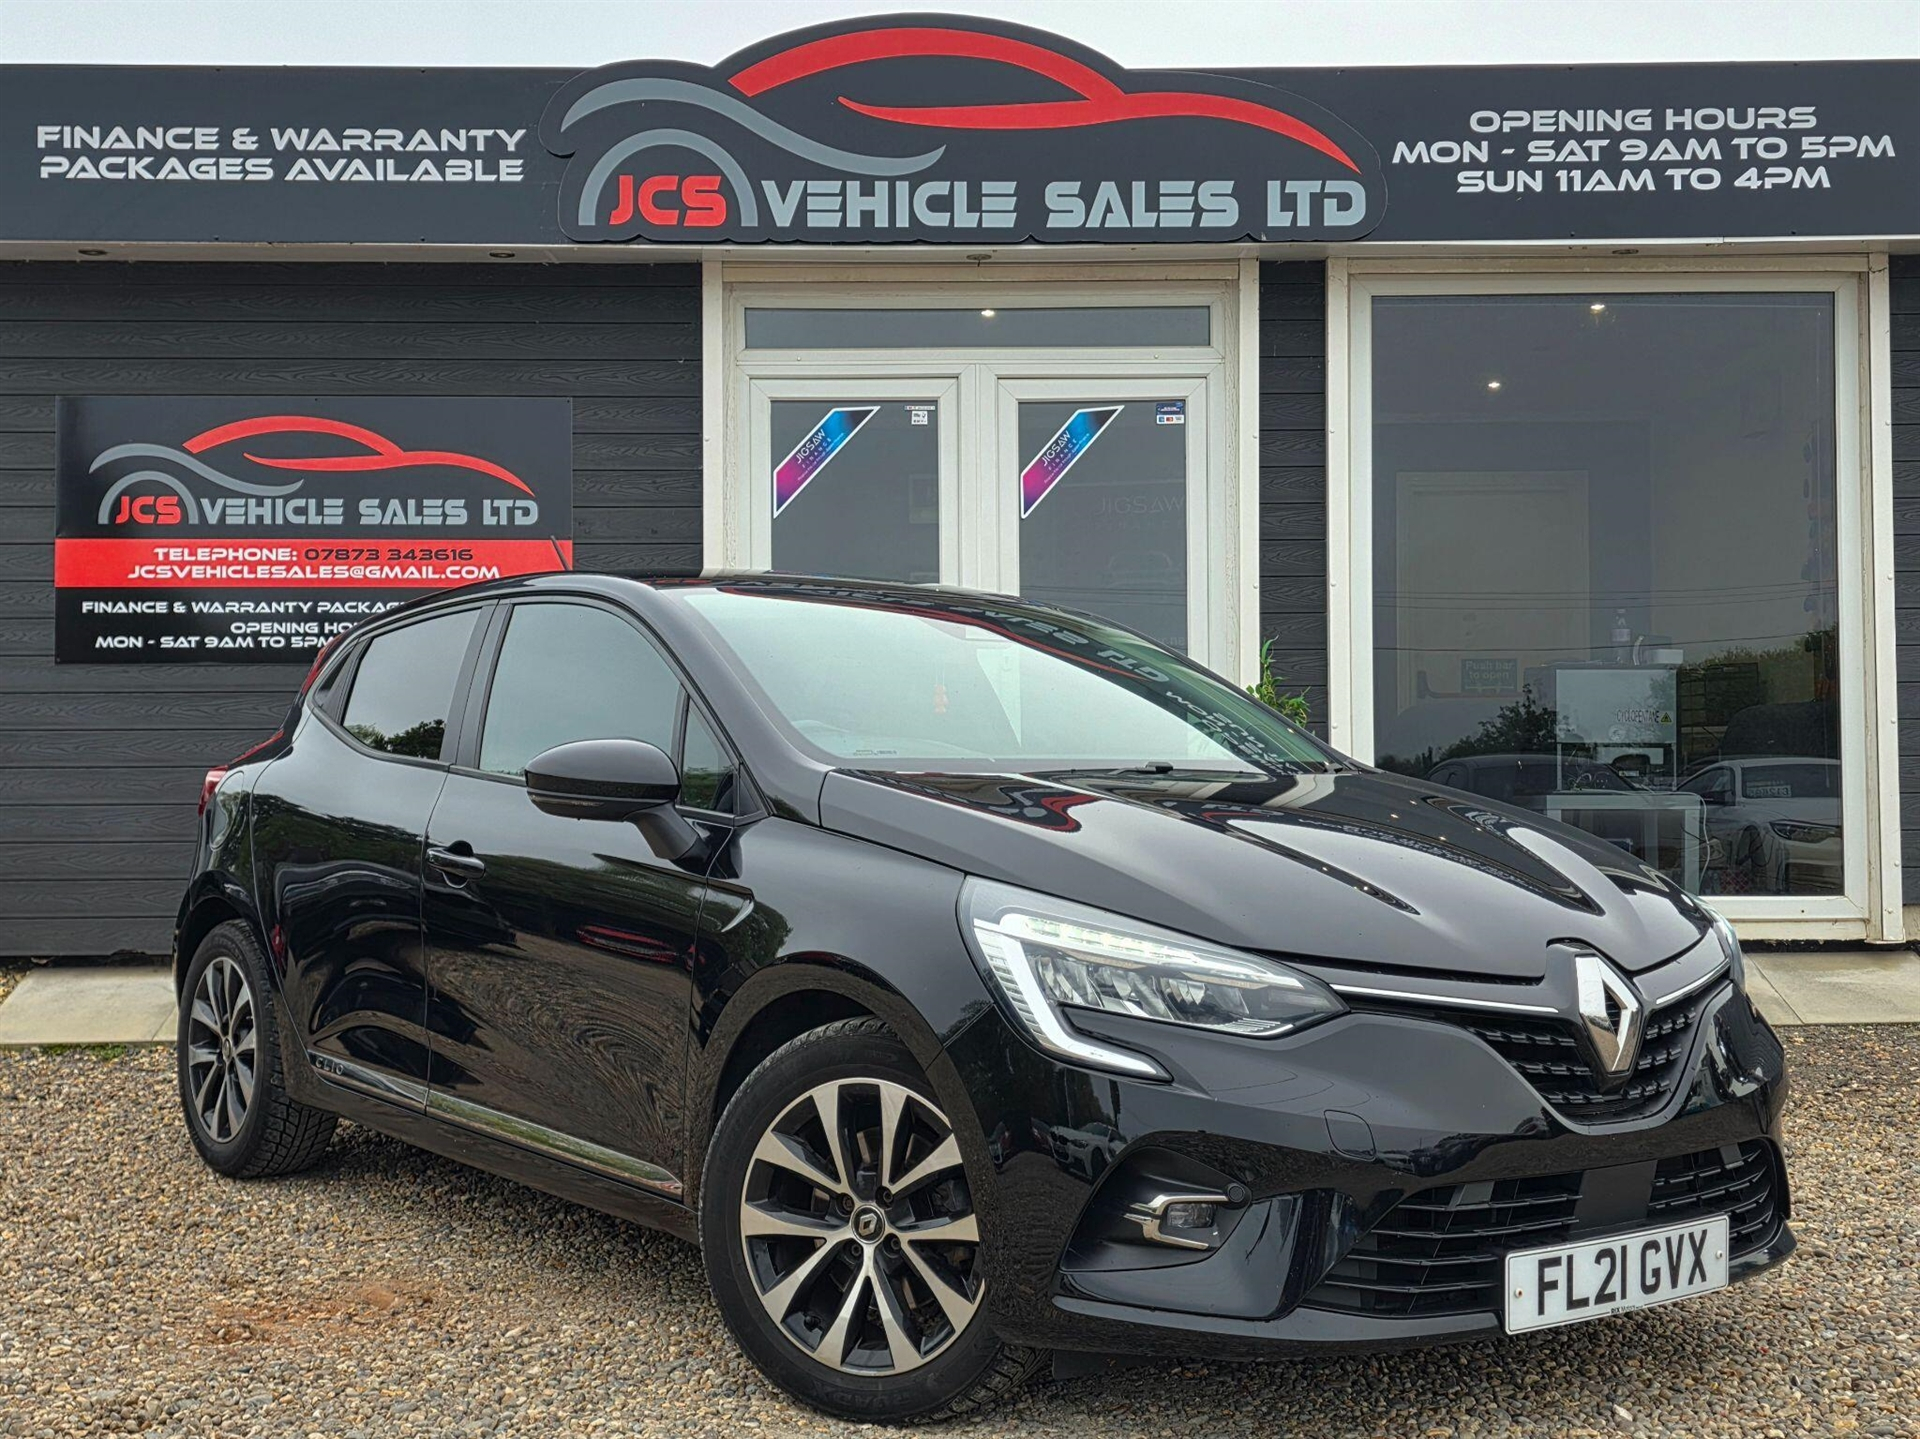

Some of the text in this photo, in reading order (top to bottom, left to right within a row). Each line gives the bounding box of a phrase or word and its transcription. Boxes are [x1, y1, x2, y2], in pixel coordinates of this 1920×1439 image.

[1469, 106, 1817, 133] OPENING HOURS
[37, 125, 527, 152] FINANCE & WARRANTY
[1391, 140, 1489, 164] MON
[1527, 139, 1611, 163] SAT
[1619, 137, 1723, 162] 9AM
[1730, 136, 1788, 160] TO
[1800, 134, 1896, 159] 5PM
[40, 155, 525, 182] PACKAGES AVAILABLE
[1456, 165, 1831, 193] SUN 11AM TO 4PM
[608, 174, 1367, 228] JCS VEHICLE SALES LTD
[796, 428, 826, 464] JIGSAW
[1041, 429, 1071, 467] JIGSAW
[114, 495, 539, 526] JCS VEHICLE SALES LTD
[153, 547, 474, 562] TELEPHONE: 07873 343616
[127, 565, 501, 580] JCSVEHICLESALES@GMAIL.COM
[81, 601, 169, 614] FINANCE
[172, 601, 187, 614] &
[190, 601, 313, 614] WARRANTY
[230, 621, 319, 634] OPENING
[94, 635, 143, 649] MON
[159, 635, 201, 649] SAT
[203, 635, 255, 648] 9AM
[257, 635, 286, 648] TO
[315, 1057, 344, 1076] CLIO
[1537, 1228, 1709, 1316] FL21 GVX
